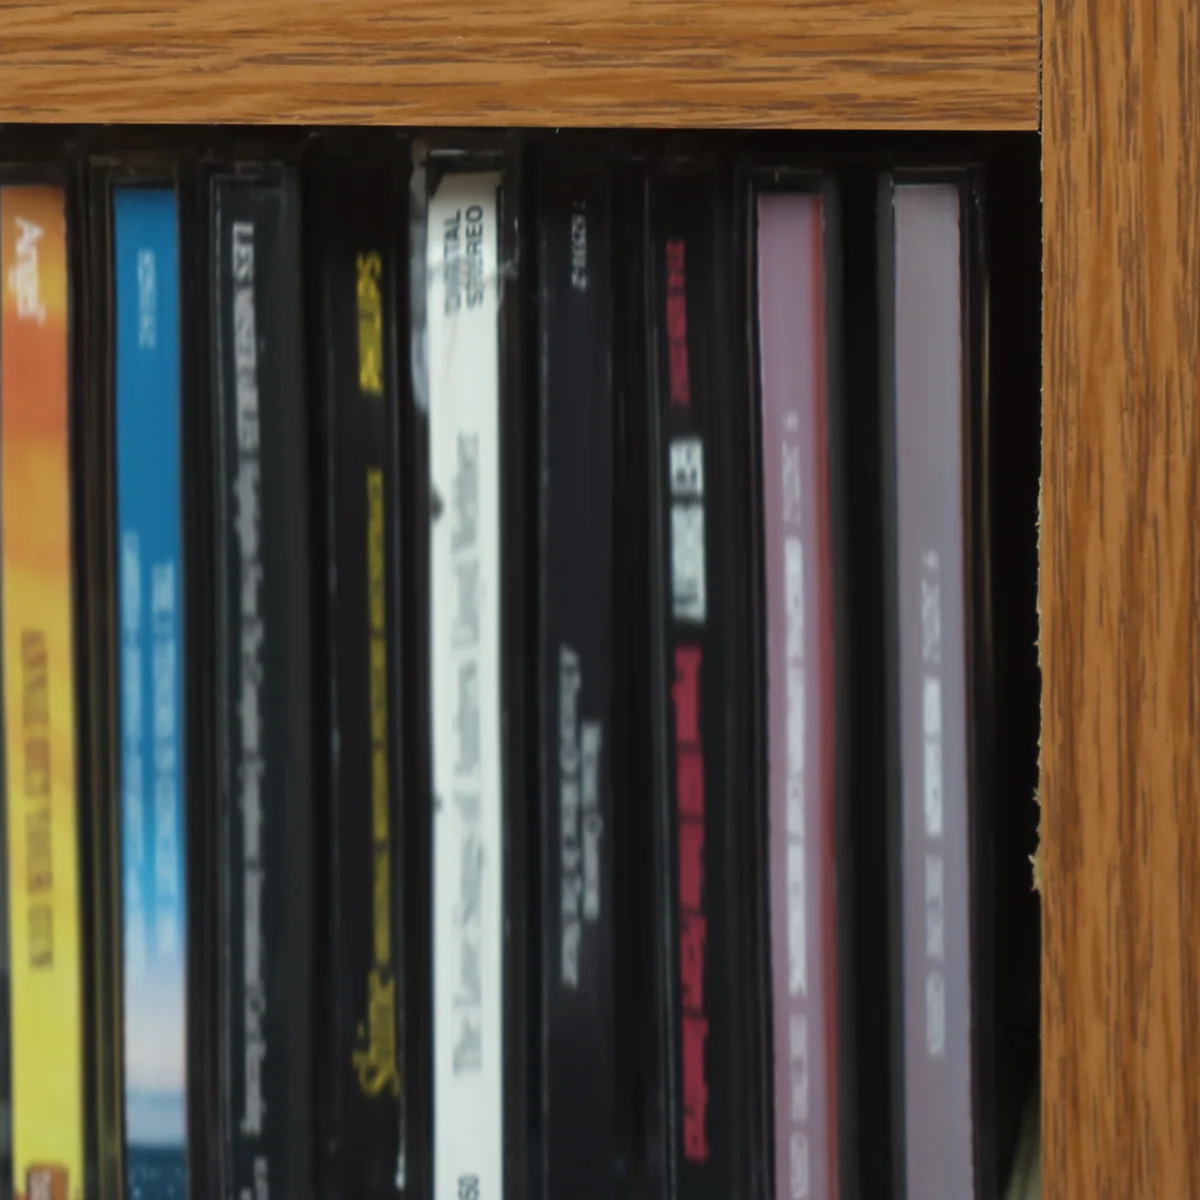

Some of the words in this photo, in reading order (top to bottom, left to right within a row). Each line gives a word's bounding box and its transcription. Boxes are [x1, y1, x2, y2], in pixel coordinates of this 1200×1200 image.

[7, 218, 44, 319] Angel
[232, 221, 254, 281] LES
[356, 250, 384, 393] PHILIPS
